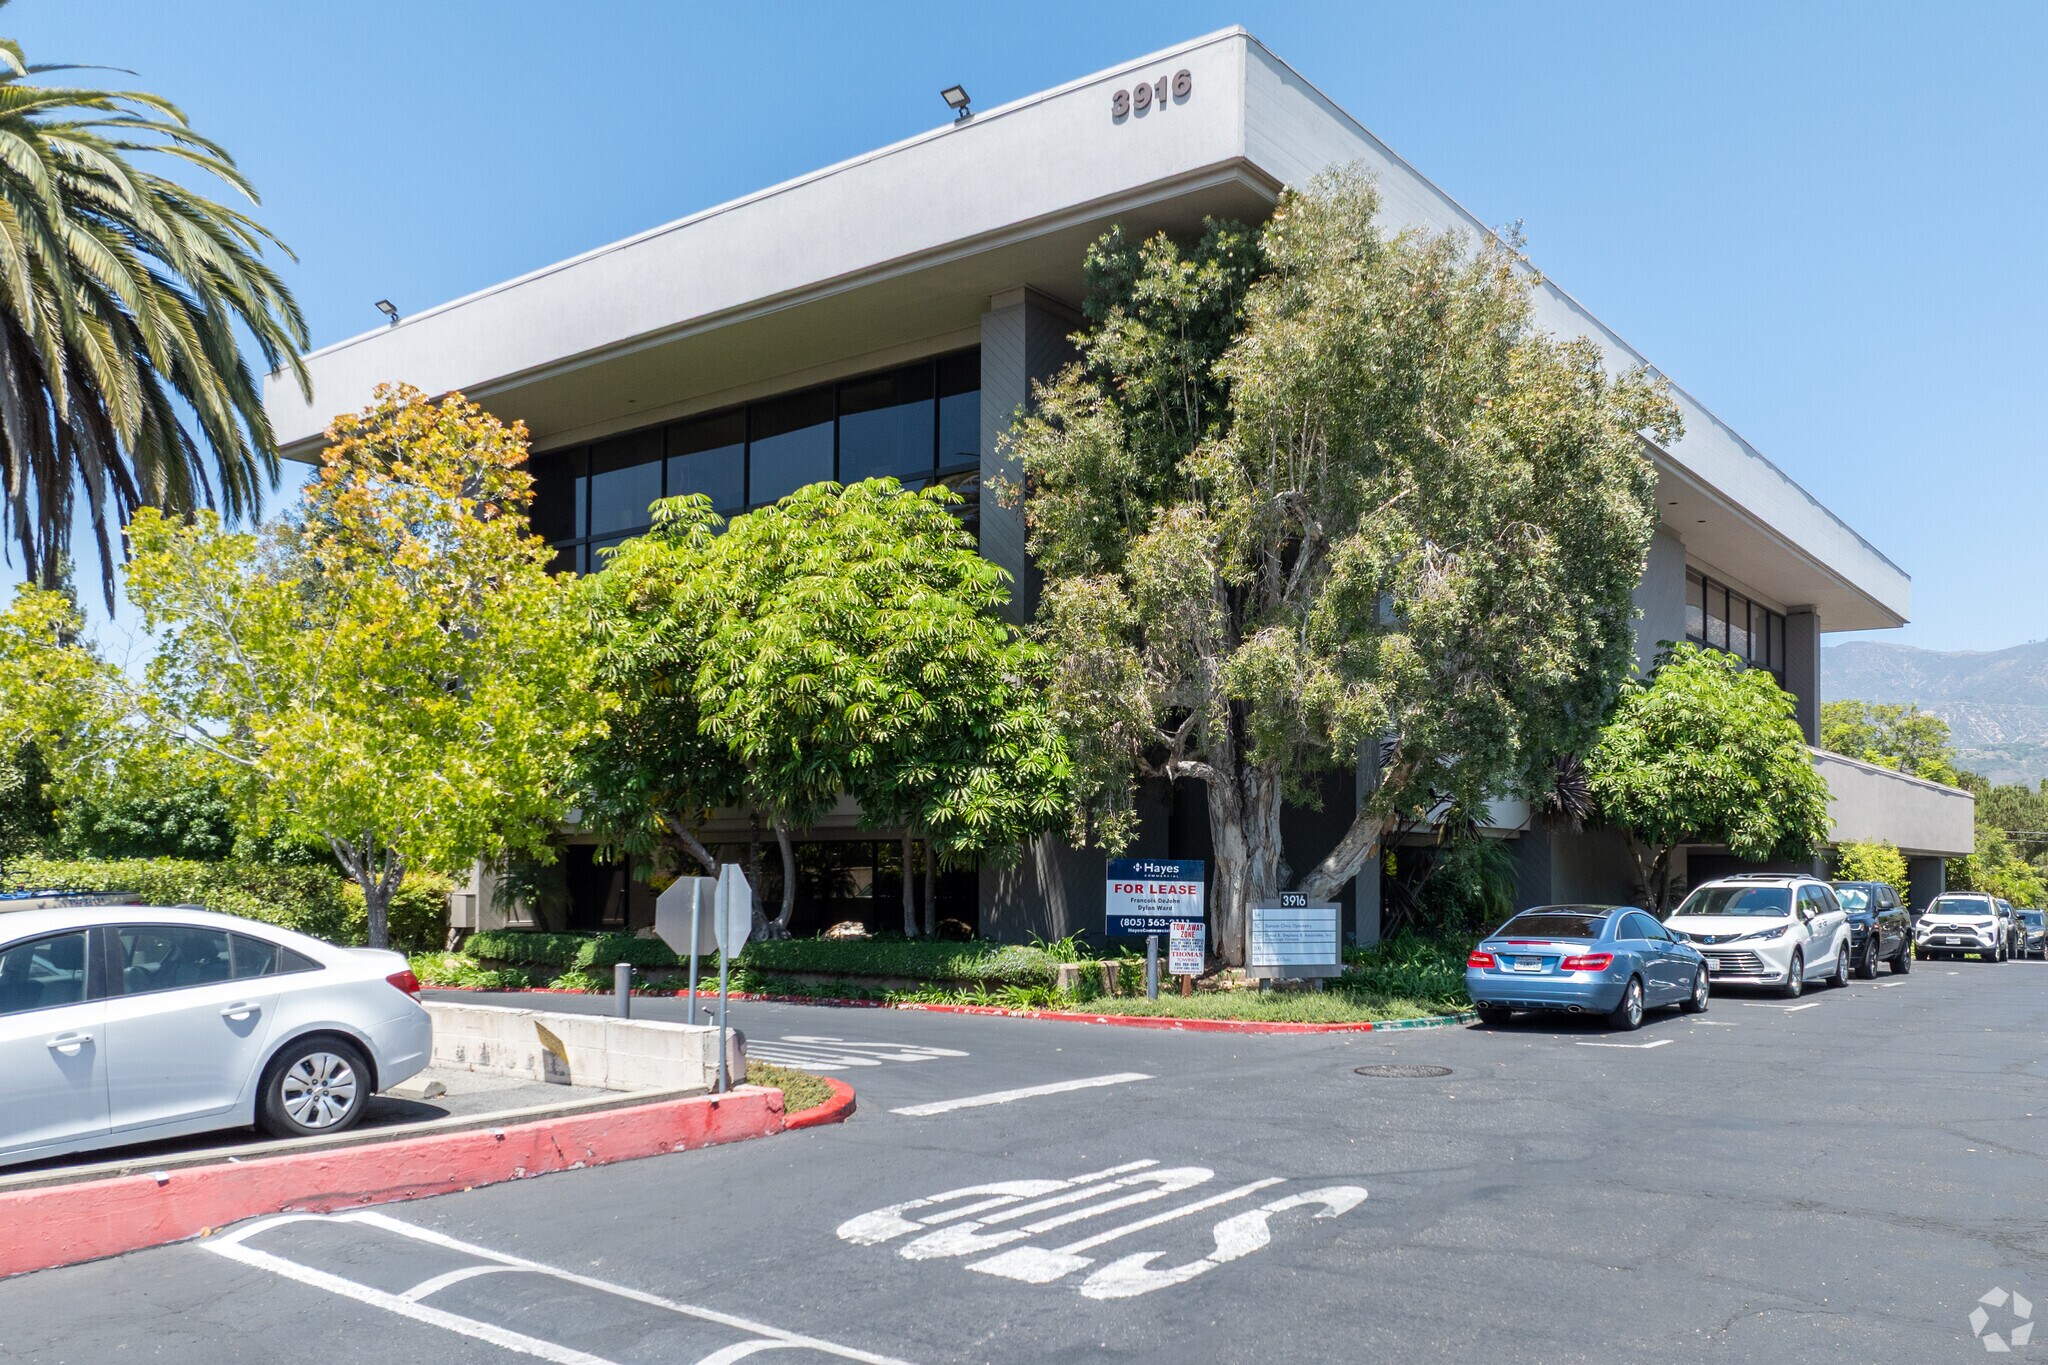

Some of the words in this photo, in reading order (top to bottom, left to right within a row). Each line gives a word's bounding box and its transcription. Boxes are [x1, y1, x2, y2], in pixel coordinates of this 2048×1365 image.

[1111, 69, 1191, 117] 3916
[1144, 862, 1179, 874] Hayes
[1114, 884, 1144, 894] FOR
[1150, 884, 1197, 895] LEASE
[1282, 895, 1306, 906] 3916
[1120, 918, 1146, 927] (805)
[1172, 923, 1185, 931] TOW
[836, 1159, 1369, 1300] STOP
